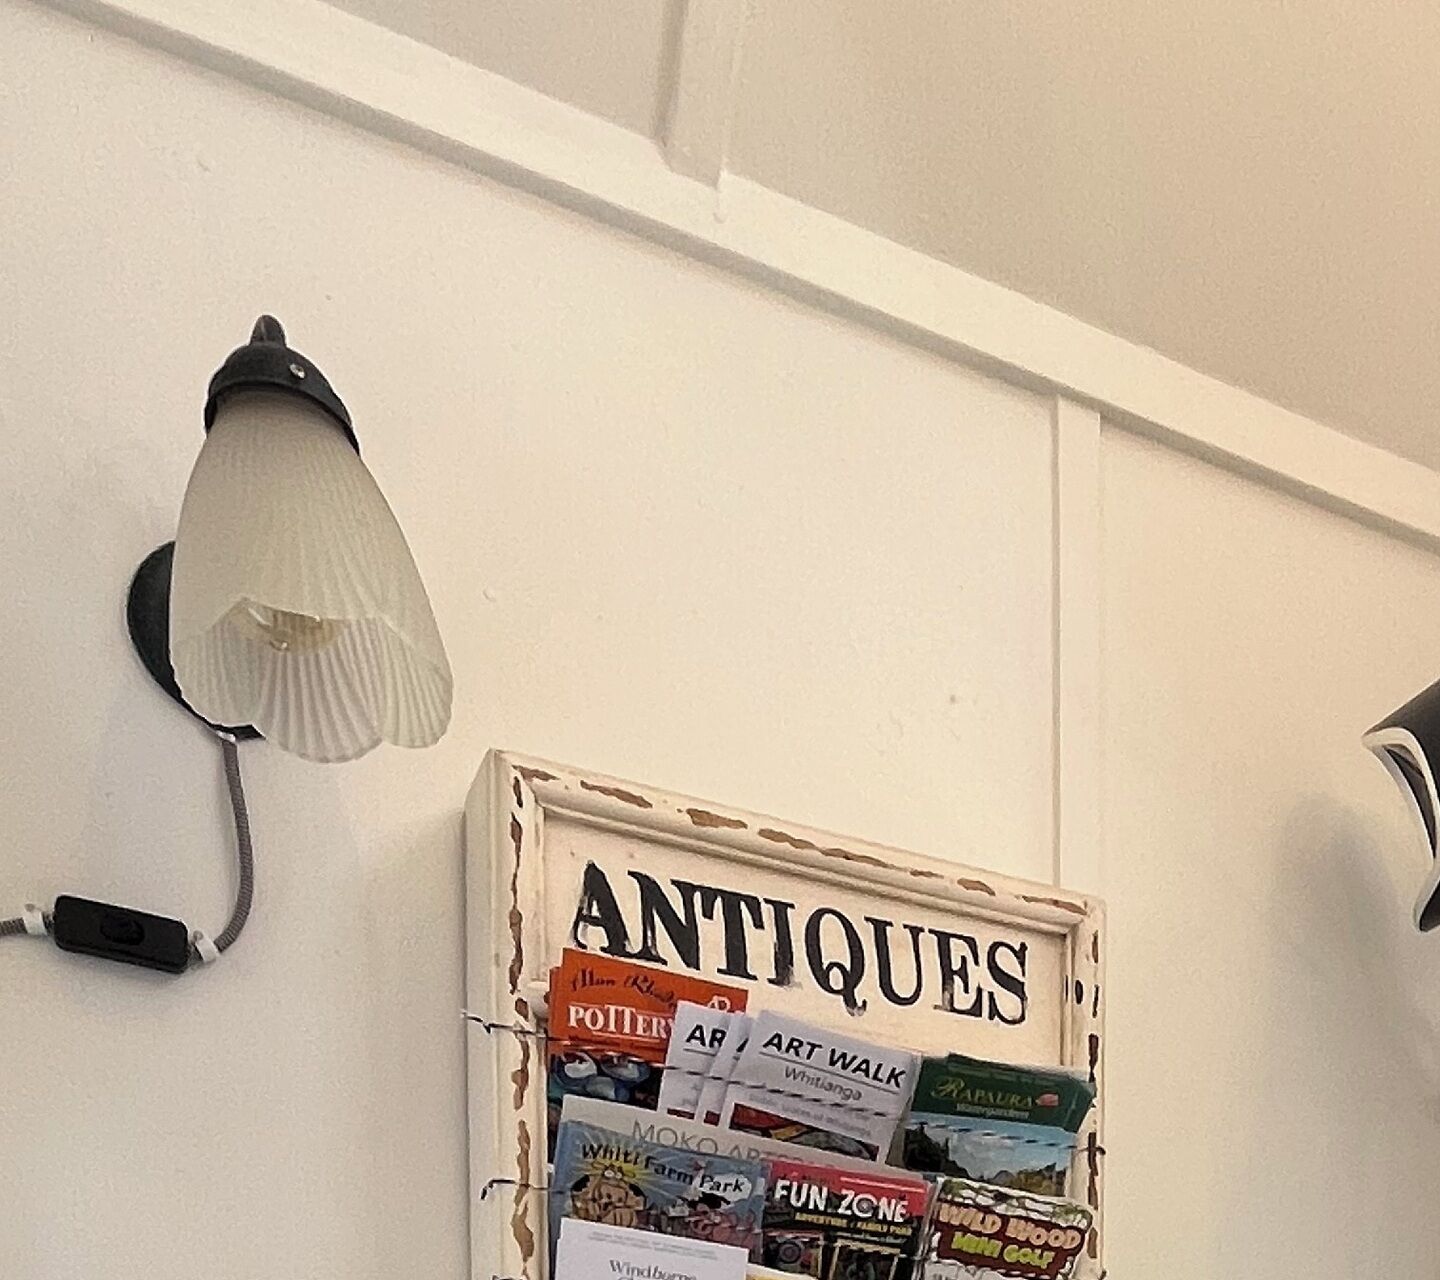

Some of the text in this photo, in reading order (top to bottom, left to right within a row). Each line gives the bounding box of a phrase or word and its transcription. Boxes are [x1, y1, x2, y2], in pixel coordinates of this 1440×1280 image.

[571, 860, 1029, 1026] ANTIQUES
[686, 1023, 728, 1050] AR
[762, 1032, 907, 1089] ART WALK
[784, 1065, 863, 1102] Whitianga
[631, 1117, 719, 1154] MOKO
[582, 1143, 746, 1194] Whiti Farm Park
[773, 1178, 910, 1223] FUN ZONE
[939, 1203, 1082, 1250] WILD WOOD
[951, 1231, 1056, 1270] MINI GOLF
